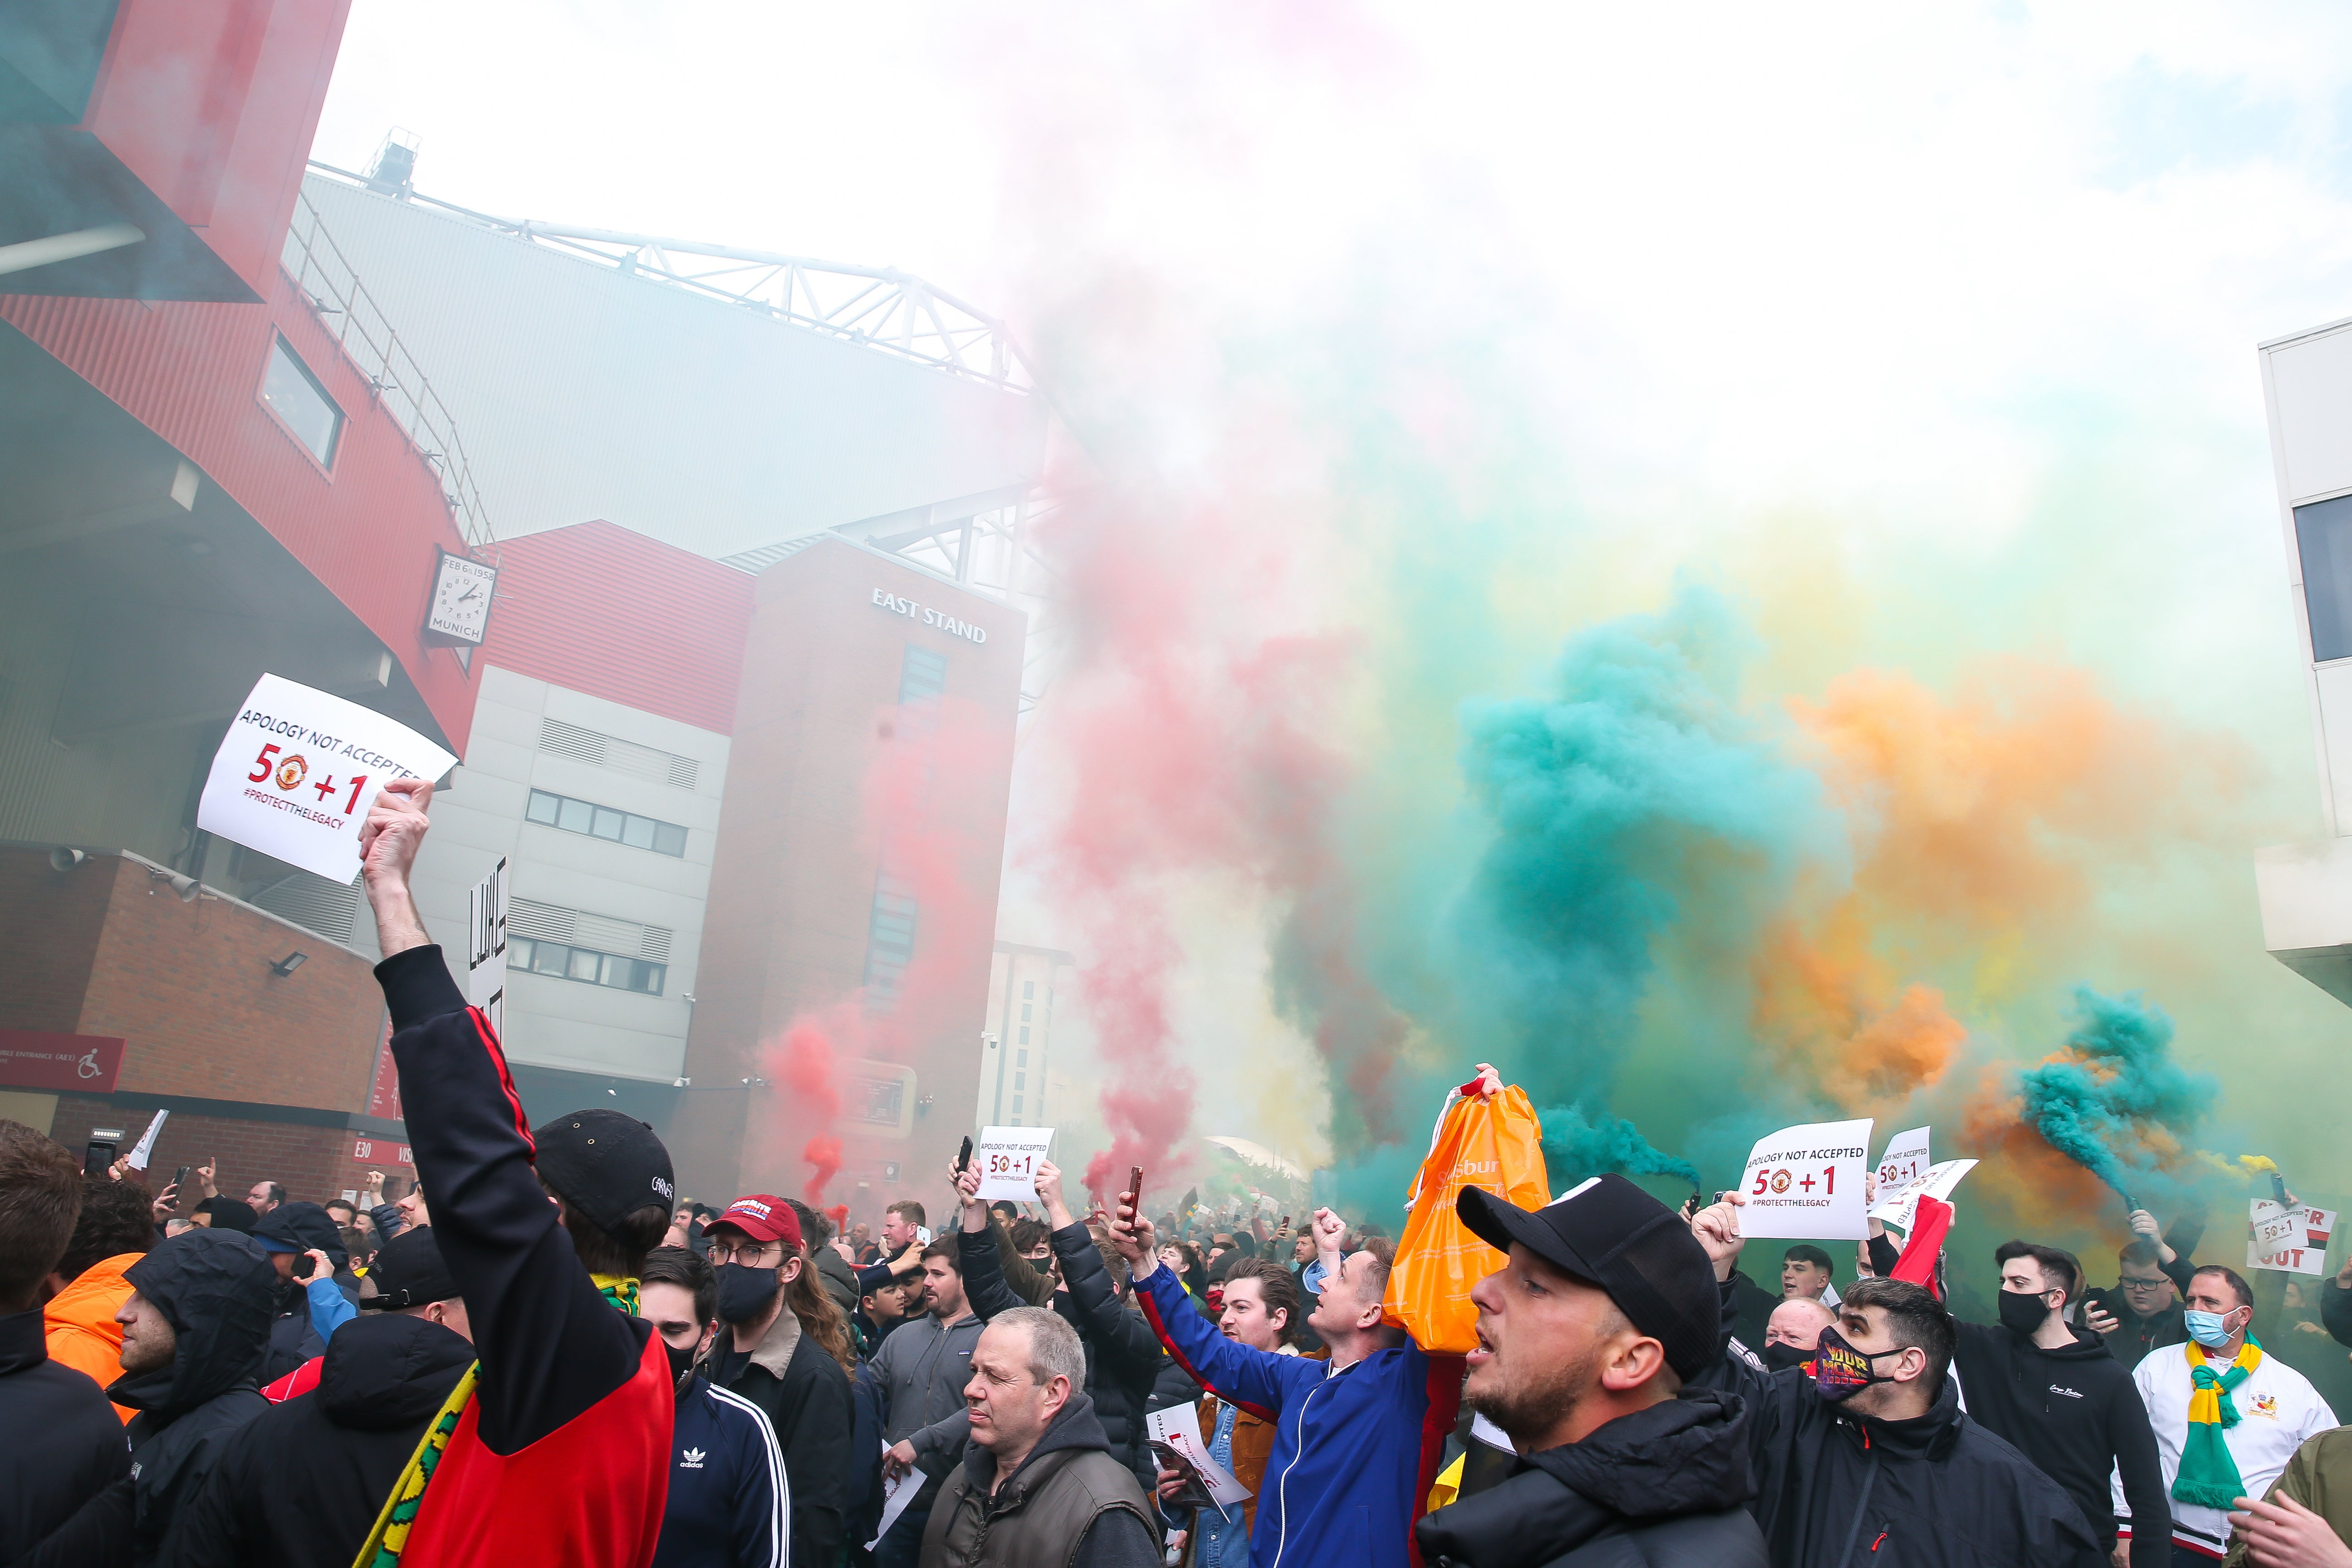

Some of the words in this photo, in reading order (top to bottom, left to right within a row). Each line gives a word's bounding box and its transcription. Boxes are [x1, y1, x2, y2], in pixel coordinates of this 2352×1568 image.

[443, 559, 461, 570] FEB
[474, 568, 494, 581] 1958
[872, 587, 920, 618] EAST
[922, 607, 987, 644] STAND
[433, 617, 480, 638] MUNICH
[239, 709, 309, 740] APOLOGY
[308, 731, 342, 751] NOT
[341, 744, 421, 779] ACCEPTE
[243, 788, 345, 831] #PROTECTTHELEGACY
[15, 1051, 53, 1059] ENTRANCE
[354, 1141, 372, 1158] E30
[1746, 1152, 1784, 1170] APOLOGY
[1785, 1150, 1808, 1161] NOT
[1808, 1147, 1864, 1160] ACCEPTED
[1892, 1152, 1903, 1160] NOT
[1903, 1148, 1928, 1158] ACCEPTED
[1822, 1358, 1856, 1377] MCR
[1824, 1342, 1868, 1372] YOUR
